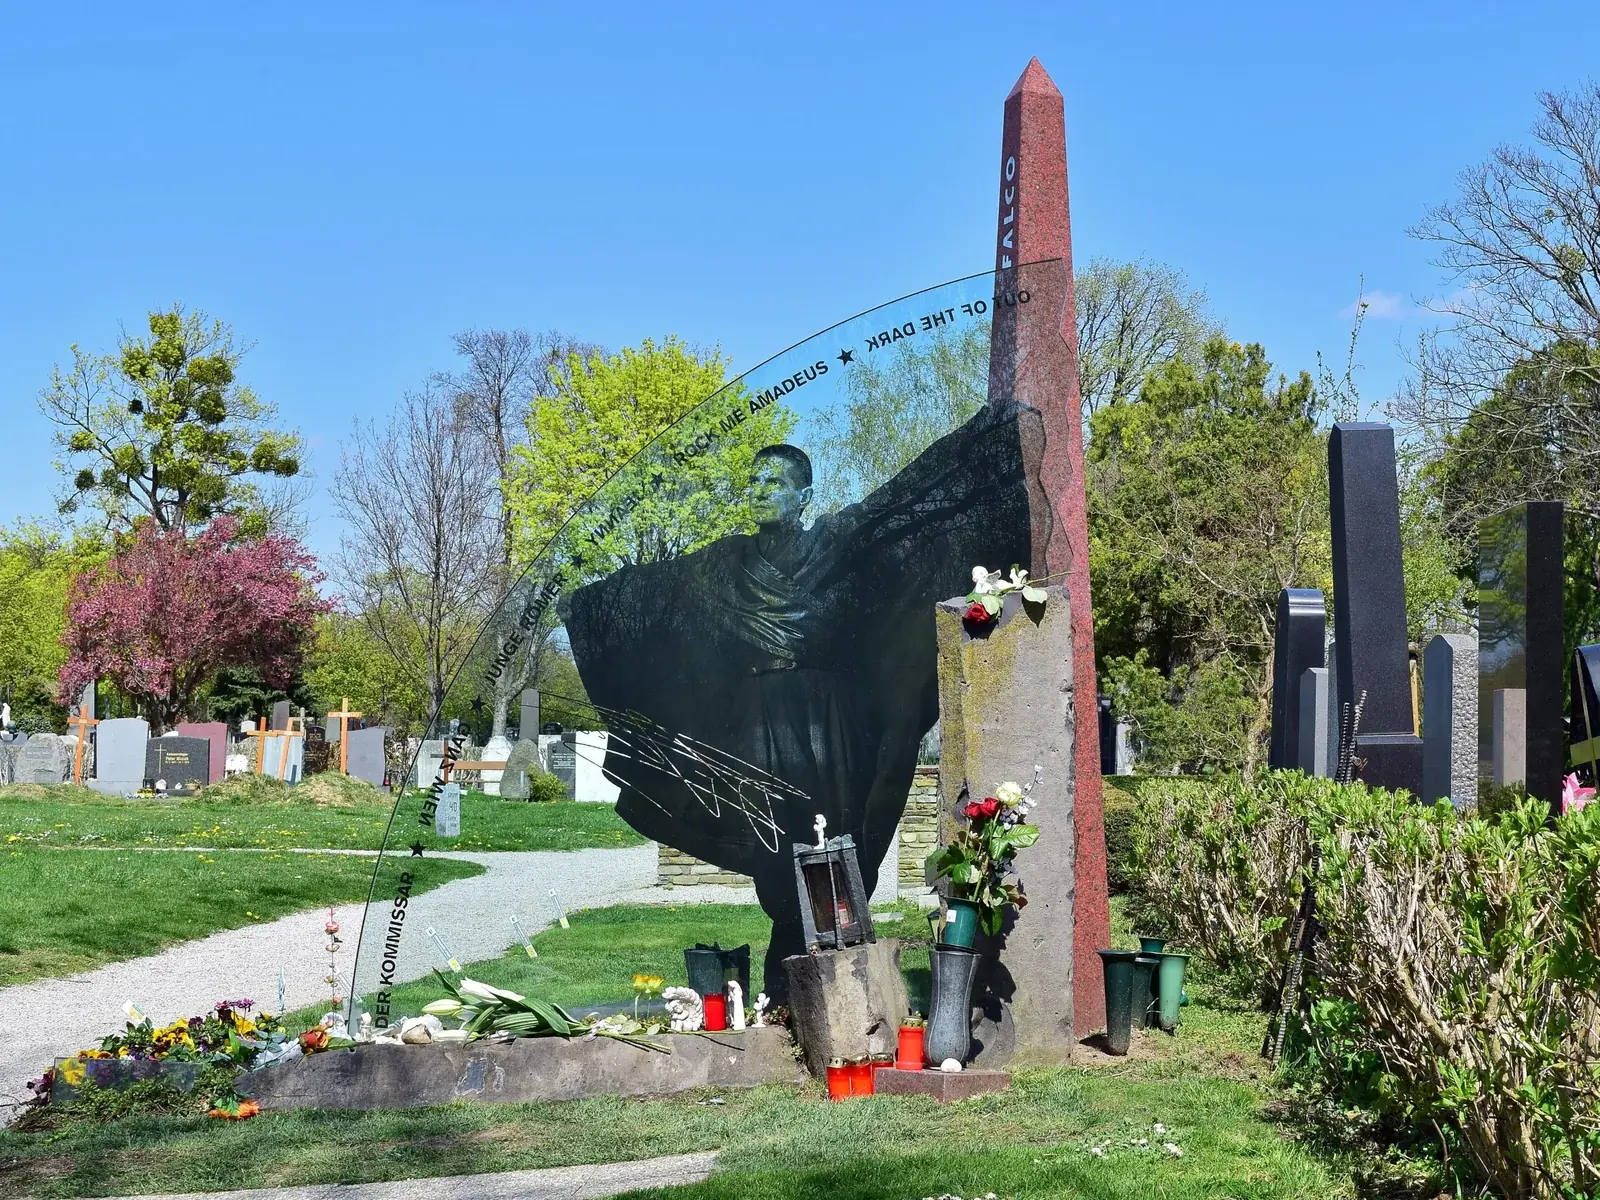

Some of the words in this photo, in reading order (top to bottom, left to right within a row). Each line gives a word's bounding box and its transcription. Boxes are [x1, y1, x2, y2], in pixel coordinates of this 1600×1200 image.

[1002, 156, 1016, 269] FALCO
[673, 428, 720, 467] ROCK
[719, 408, 748, 433] ME
[748, 360, 829, 415] AMADEUS
[484, 631, 525, 687] JUNGE
[379, 871, 415, 986] KOMMISSAR
[374, 990, 392, 1029] DER
